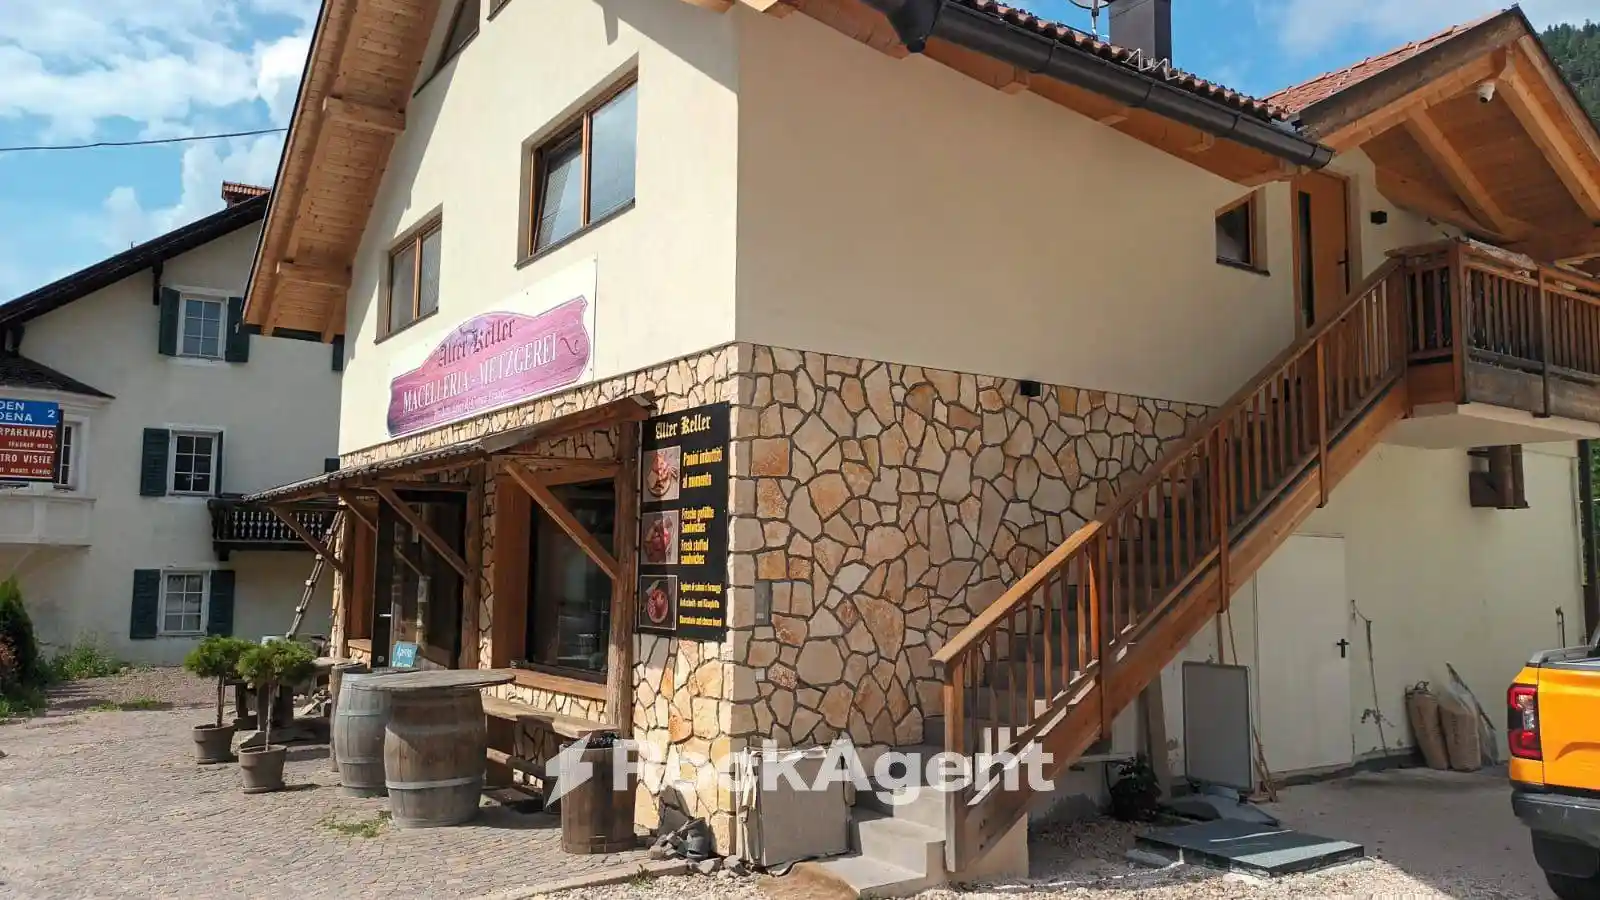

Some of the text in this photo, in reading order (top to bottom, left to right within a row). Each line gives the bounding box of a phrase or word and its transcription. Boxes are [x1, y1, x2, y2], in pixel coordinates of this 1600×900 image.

[437, 318, 515, 367] Alter Keller
[402, 367, 469, 414] MACELLERIA
[479, 332, 557, 388] METZGEREI
[47, 408, 56, 418] 2
[655, 413, 711, 440] Alter Keller
